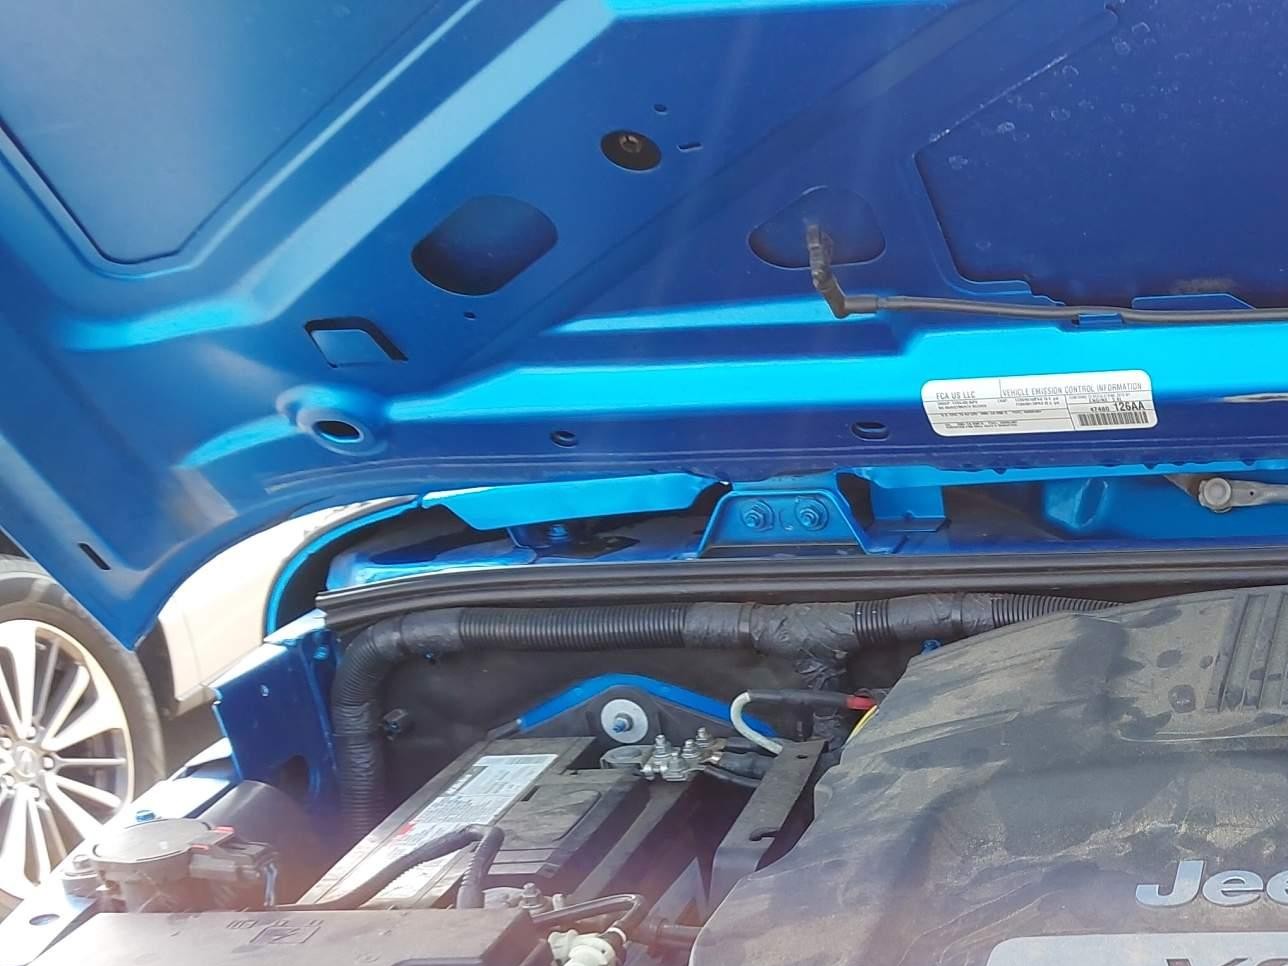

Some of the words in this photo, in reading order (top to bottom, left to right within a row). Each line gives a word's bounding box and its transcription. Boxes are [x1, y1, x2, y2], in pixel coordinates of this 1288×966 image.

[1002, 387, 1029, 397] VEHICLE
[1031, 385, 1062, 395] EMISSION
[1064, 384, 1095, 394] CONTROL
[1096, 382, 1142, 392] INFORMATION
[936, 392, 949, 400] FCA
[952, 391, 961, 399] US
[963, 391, 976, 399] LLC
[1114, 402, 1146, 412] 126AA
